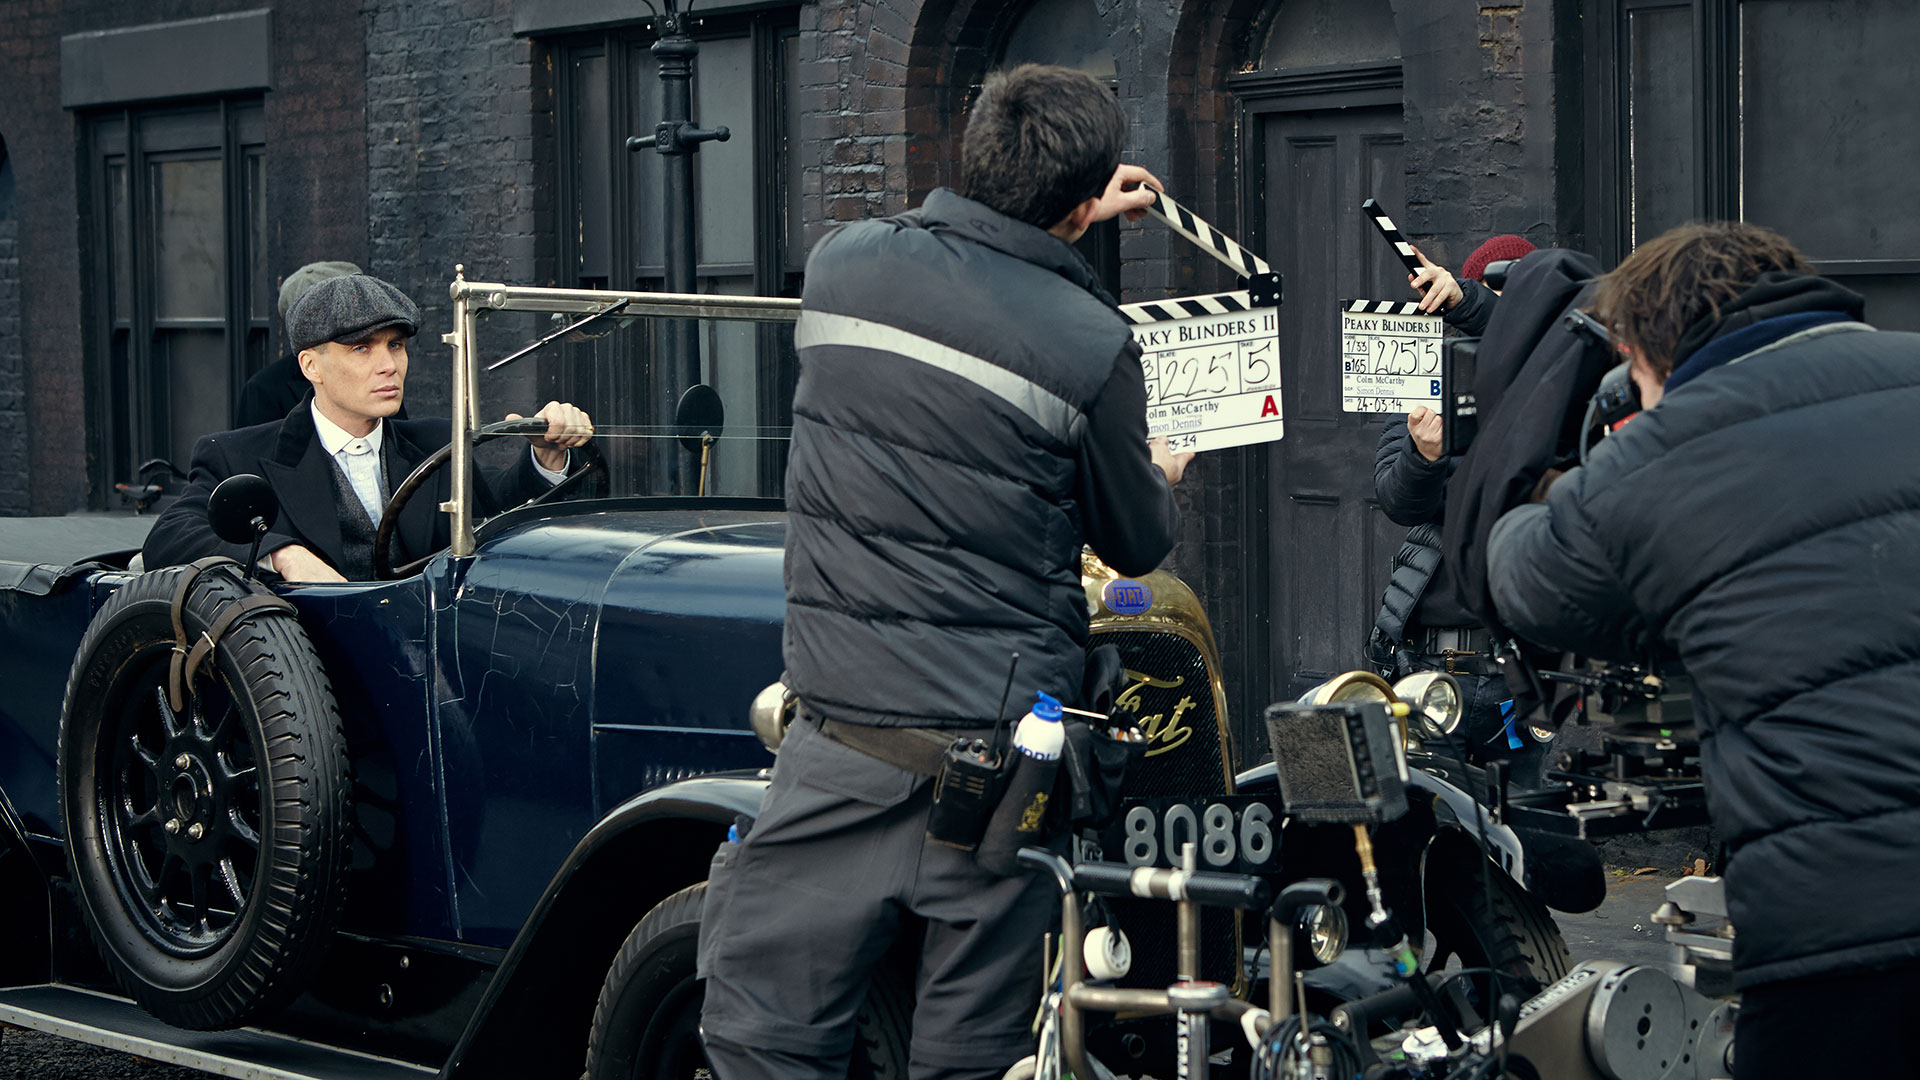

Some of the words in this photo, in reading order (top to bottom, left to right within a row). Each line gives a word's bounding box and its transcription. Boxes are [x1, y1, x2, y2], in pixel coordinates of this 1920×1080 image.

[1137, 330, 1172, 346] AKY
[1179, 318, 1256, 342] BLINDERS
[1264, 315, 1275, 331] II
[1344, 317, 1378, 331] PEAKY
[1382, 319, 1430, 333] BLINDERS
[1434, 321, 1441, 333] II
[1346, 340, 1368, 353] 1/33
[1375, 340, 1417, 375] 225
[1423, 343, 1439, 374] 5
[1244, 340, 1271, 384] 5
[1161, 352, 1232, 401] 225
[1430, 379, 1441, 396] B
[1148, 408, 1167, 419] olm
[1171, 400, 1219, 416] McCarthy
[1261, 394, 1279, 418] A
[1150, 423, 1169, 433] mon
[1172, 417, 1202, 430] Dennis
[1116, 588, 1142, 605] FIAT
[1124, 802, 1274, 867] 8086
